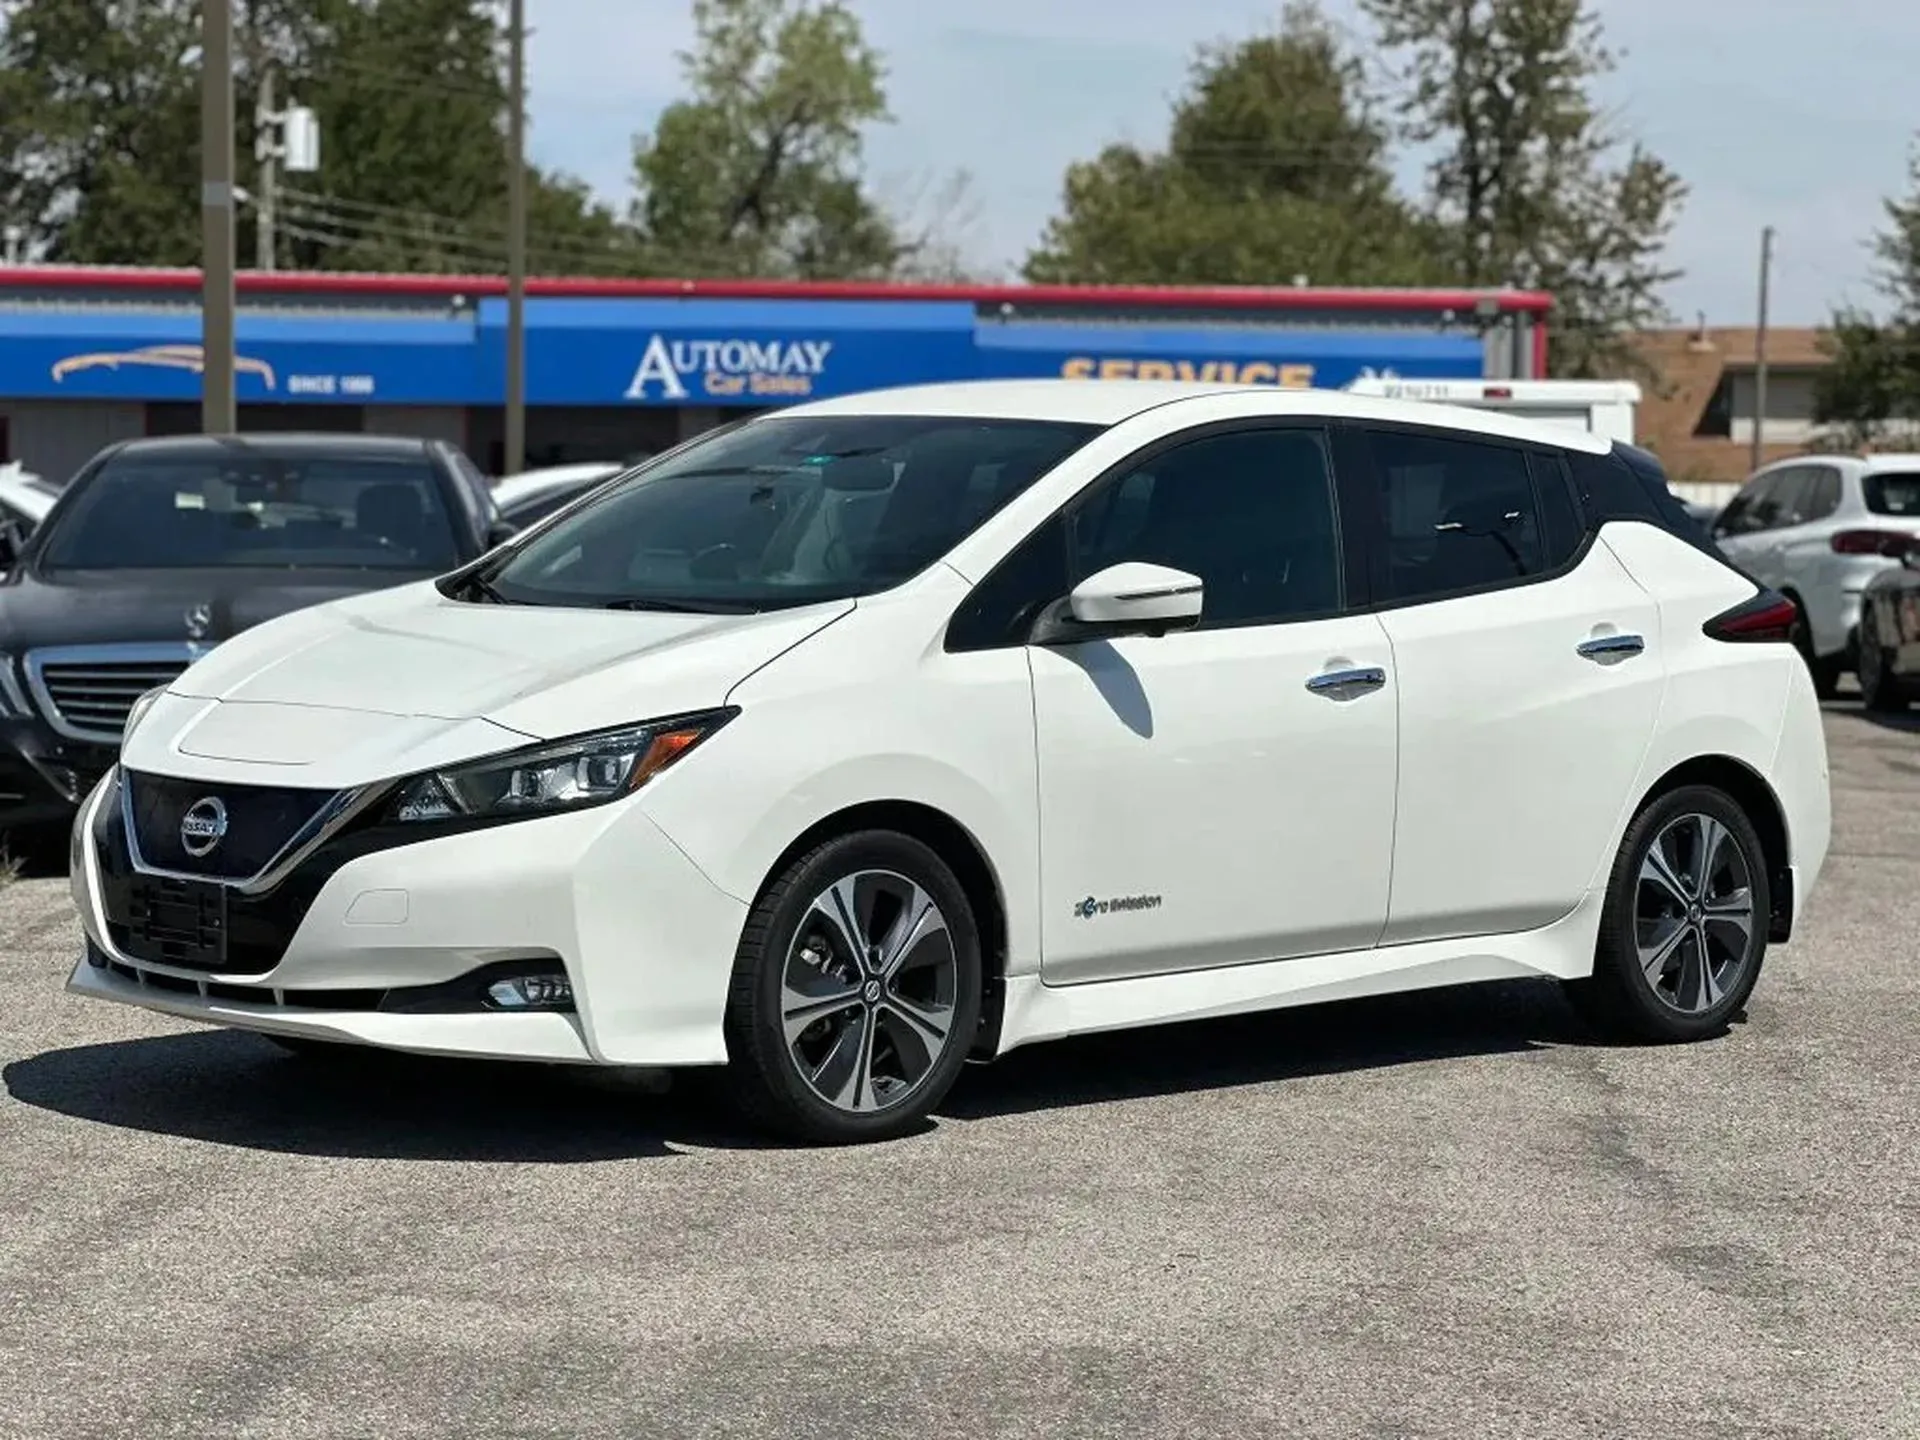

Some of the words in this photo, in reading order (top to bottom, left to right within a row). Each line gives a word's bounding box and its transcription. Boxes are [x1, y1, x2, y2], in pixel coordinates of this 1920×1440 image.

[625, 333, 832, 399] AUTOMAY
[1061, 358, 1315, 388] SERVICE
[704, 374, 745, 394] Car
[751, 373, 812, 394] Sales
